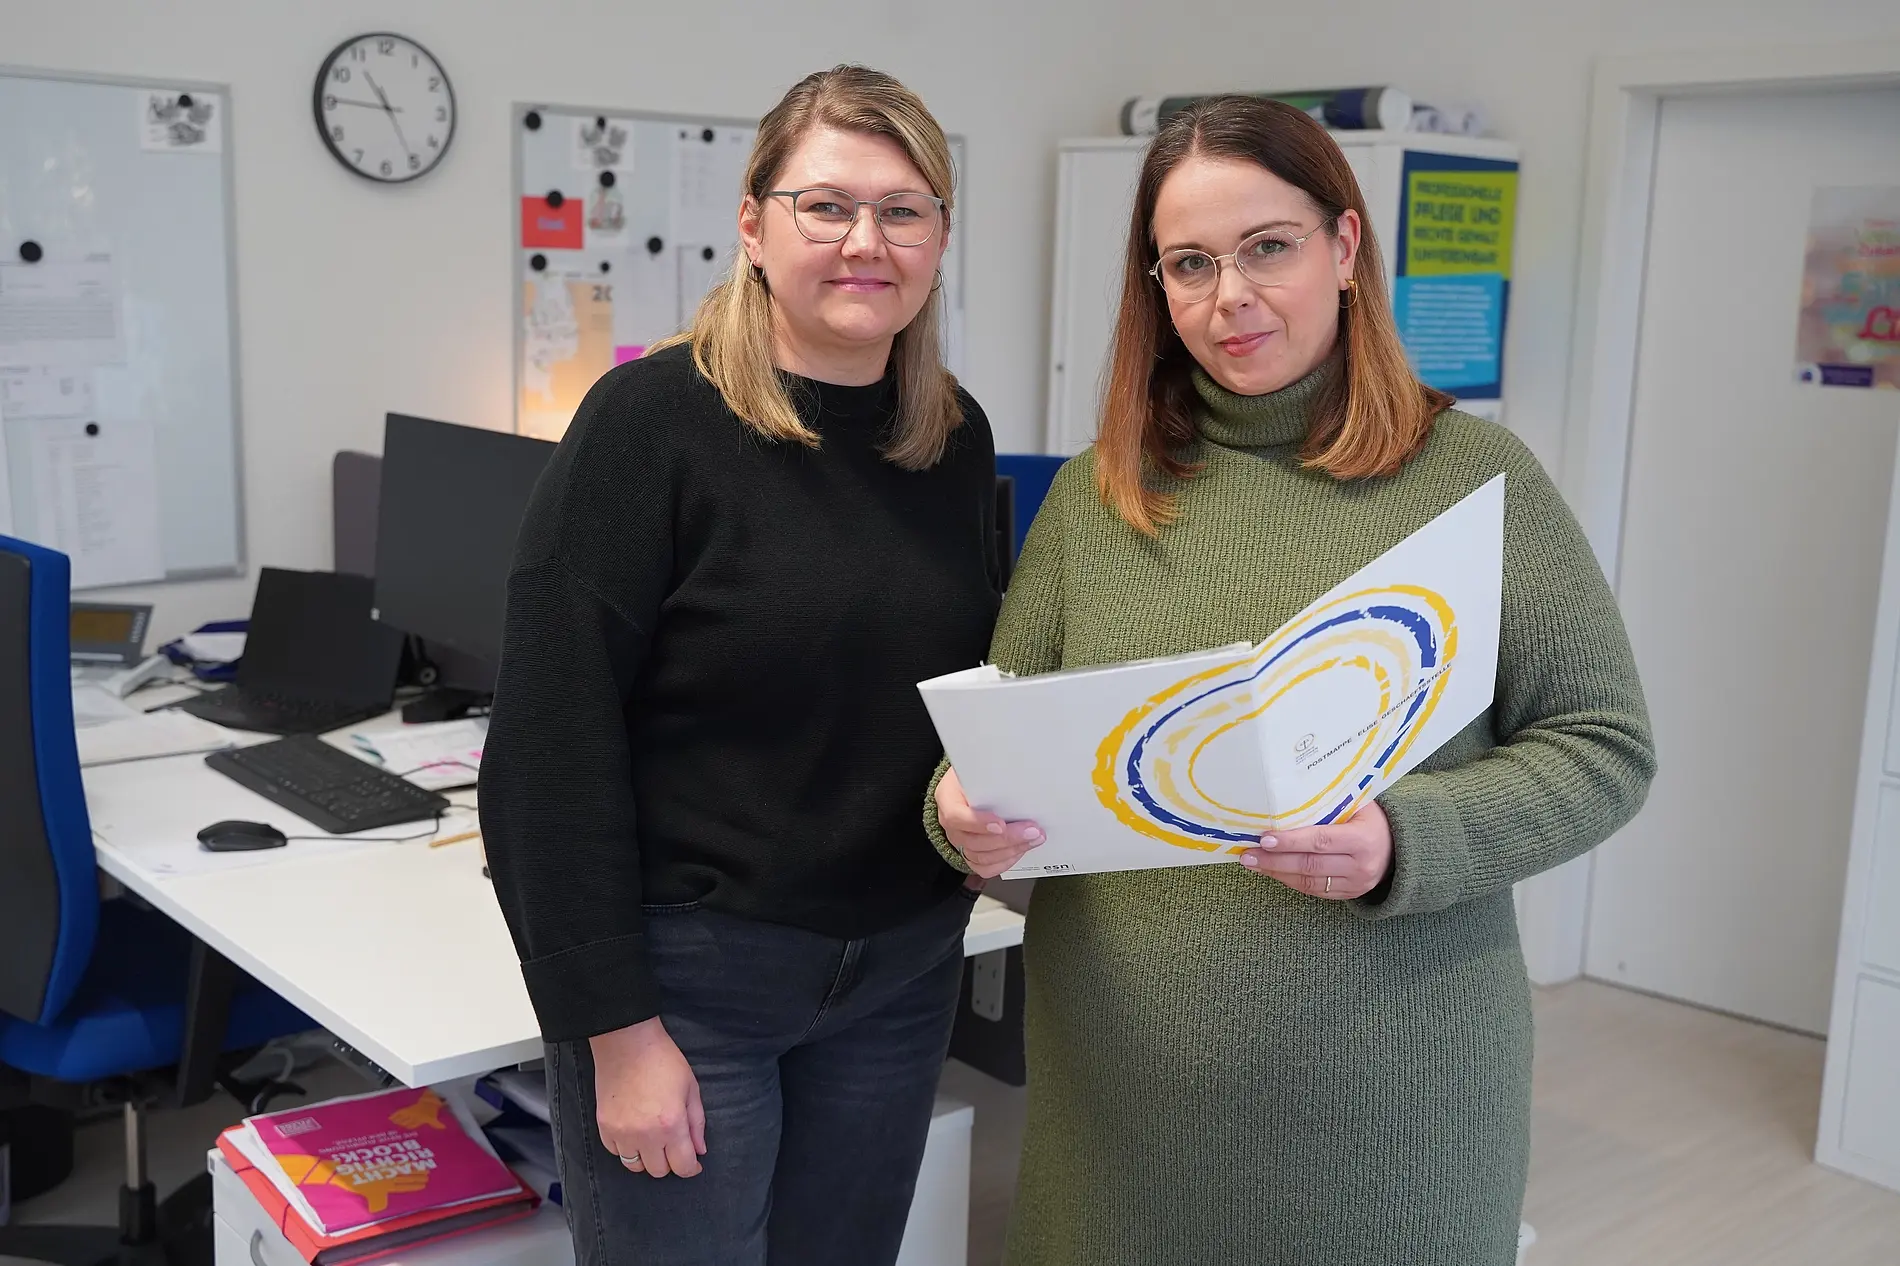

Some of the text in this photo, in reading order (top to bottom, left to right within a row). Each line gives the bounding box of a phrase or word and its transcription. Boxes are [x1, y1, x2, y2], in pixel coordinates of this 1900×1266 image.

[351, 47, 366, 63] 11
[378, 39, 395, 56] 12
[333, 66, 351, 83] 10
[428, 76, 441, 93] 2
[324, 95, 338, 111] 9
[436, 106, 447, 122] 3
[332, 125, 344, 142] 8
[427, 134, 439, 149] 4
[353, 148, 365, 165] 7
[408, 153, 421, 170] 5
[380, 159, 392, 177] 6
[1415, 201, 1501, 225] PFLEGE UND
[1307, 737, 1352, 770] POSTMAPPE
[1357, 719, 1378, 737] ELISE
[1043, 863, 1069, 871] esn
[336, 1148, 434, 1175] RICHTIG
[352, 1159, 437, 1185] MACHT
